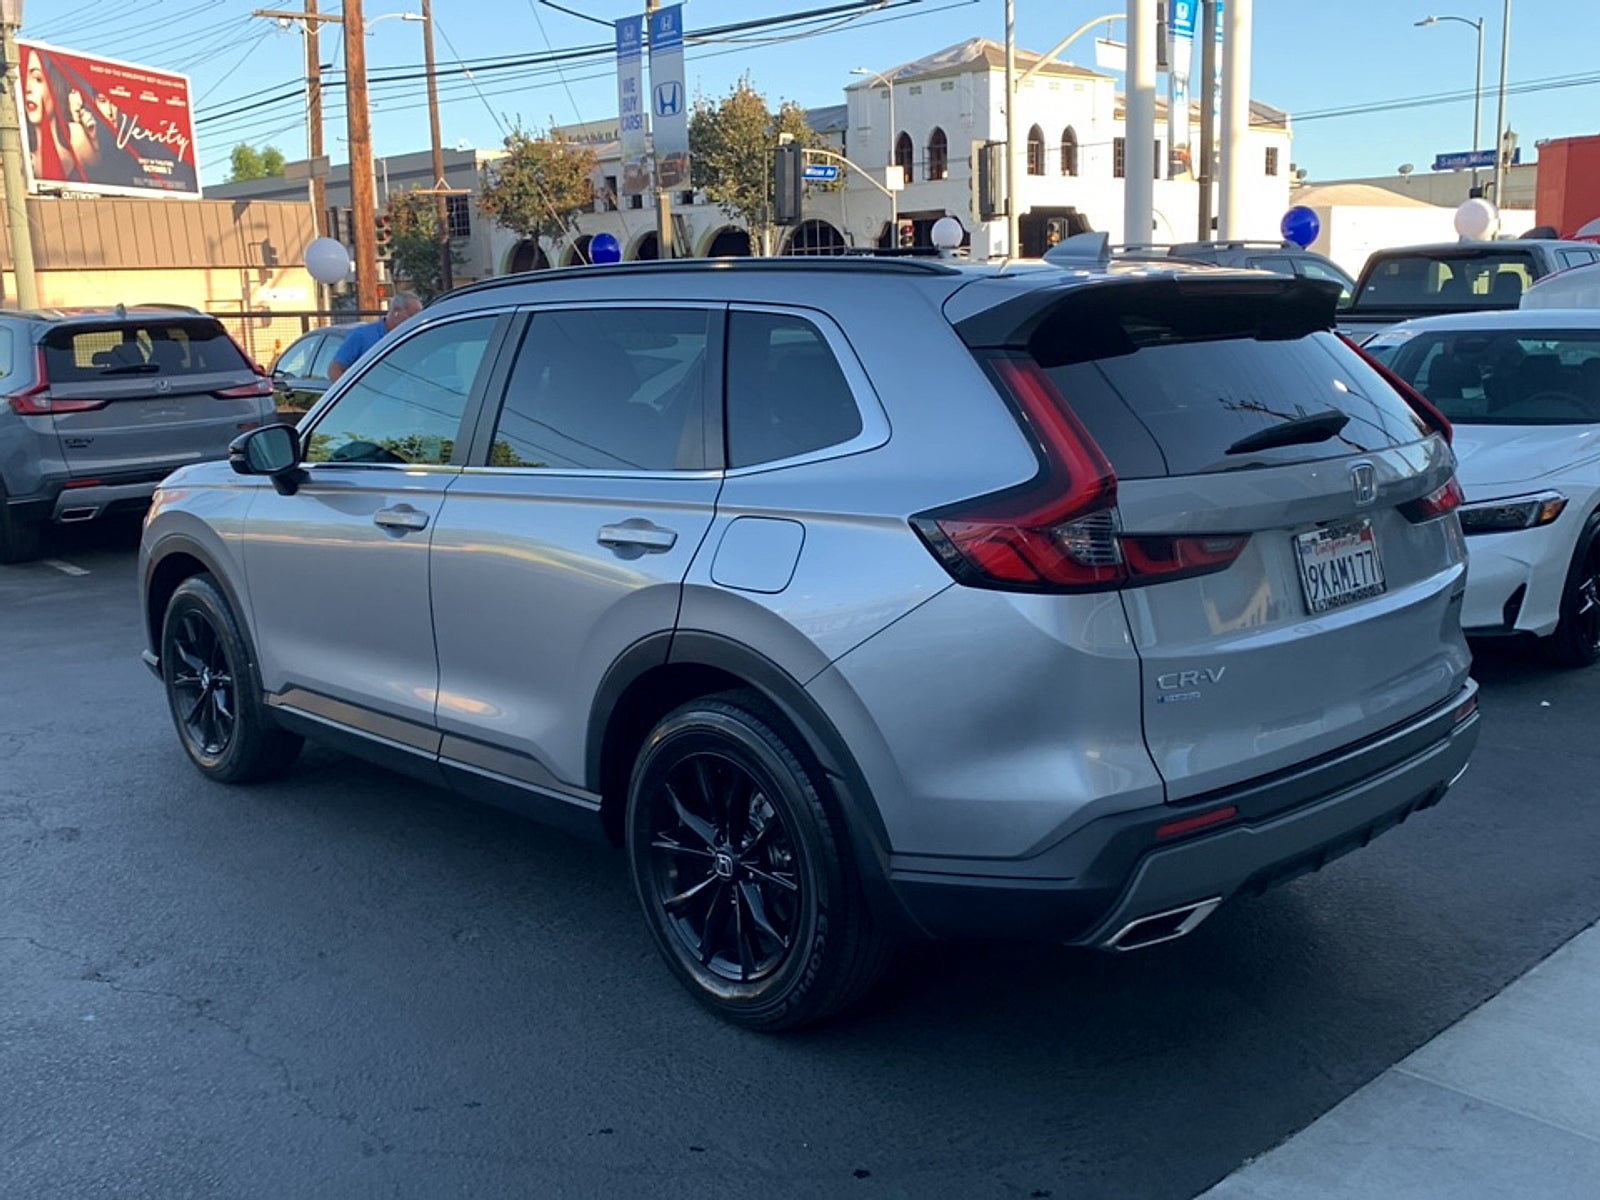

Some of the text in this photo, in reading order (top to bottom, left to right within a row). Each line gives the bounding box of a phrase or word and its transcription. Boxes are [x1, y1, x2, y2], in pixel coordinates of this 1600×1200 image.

[623, 77, 636, 93] WE
[622, 95, 638, 113] BUY
[620, 114, 643, 132] CARS!
[116, 113, 190, 163] Verity
[1308, 550, 1378, 600] 9KAM177
[1157, 666, 1226, 690] CR-V
